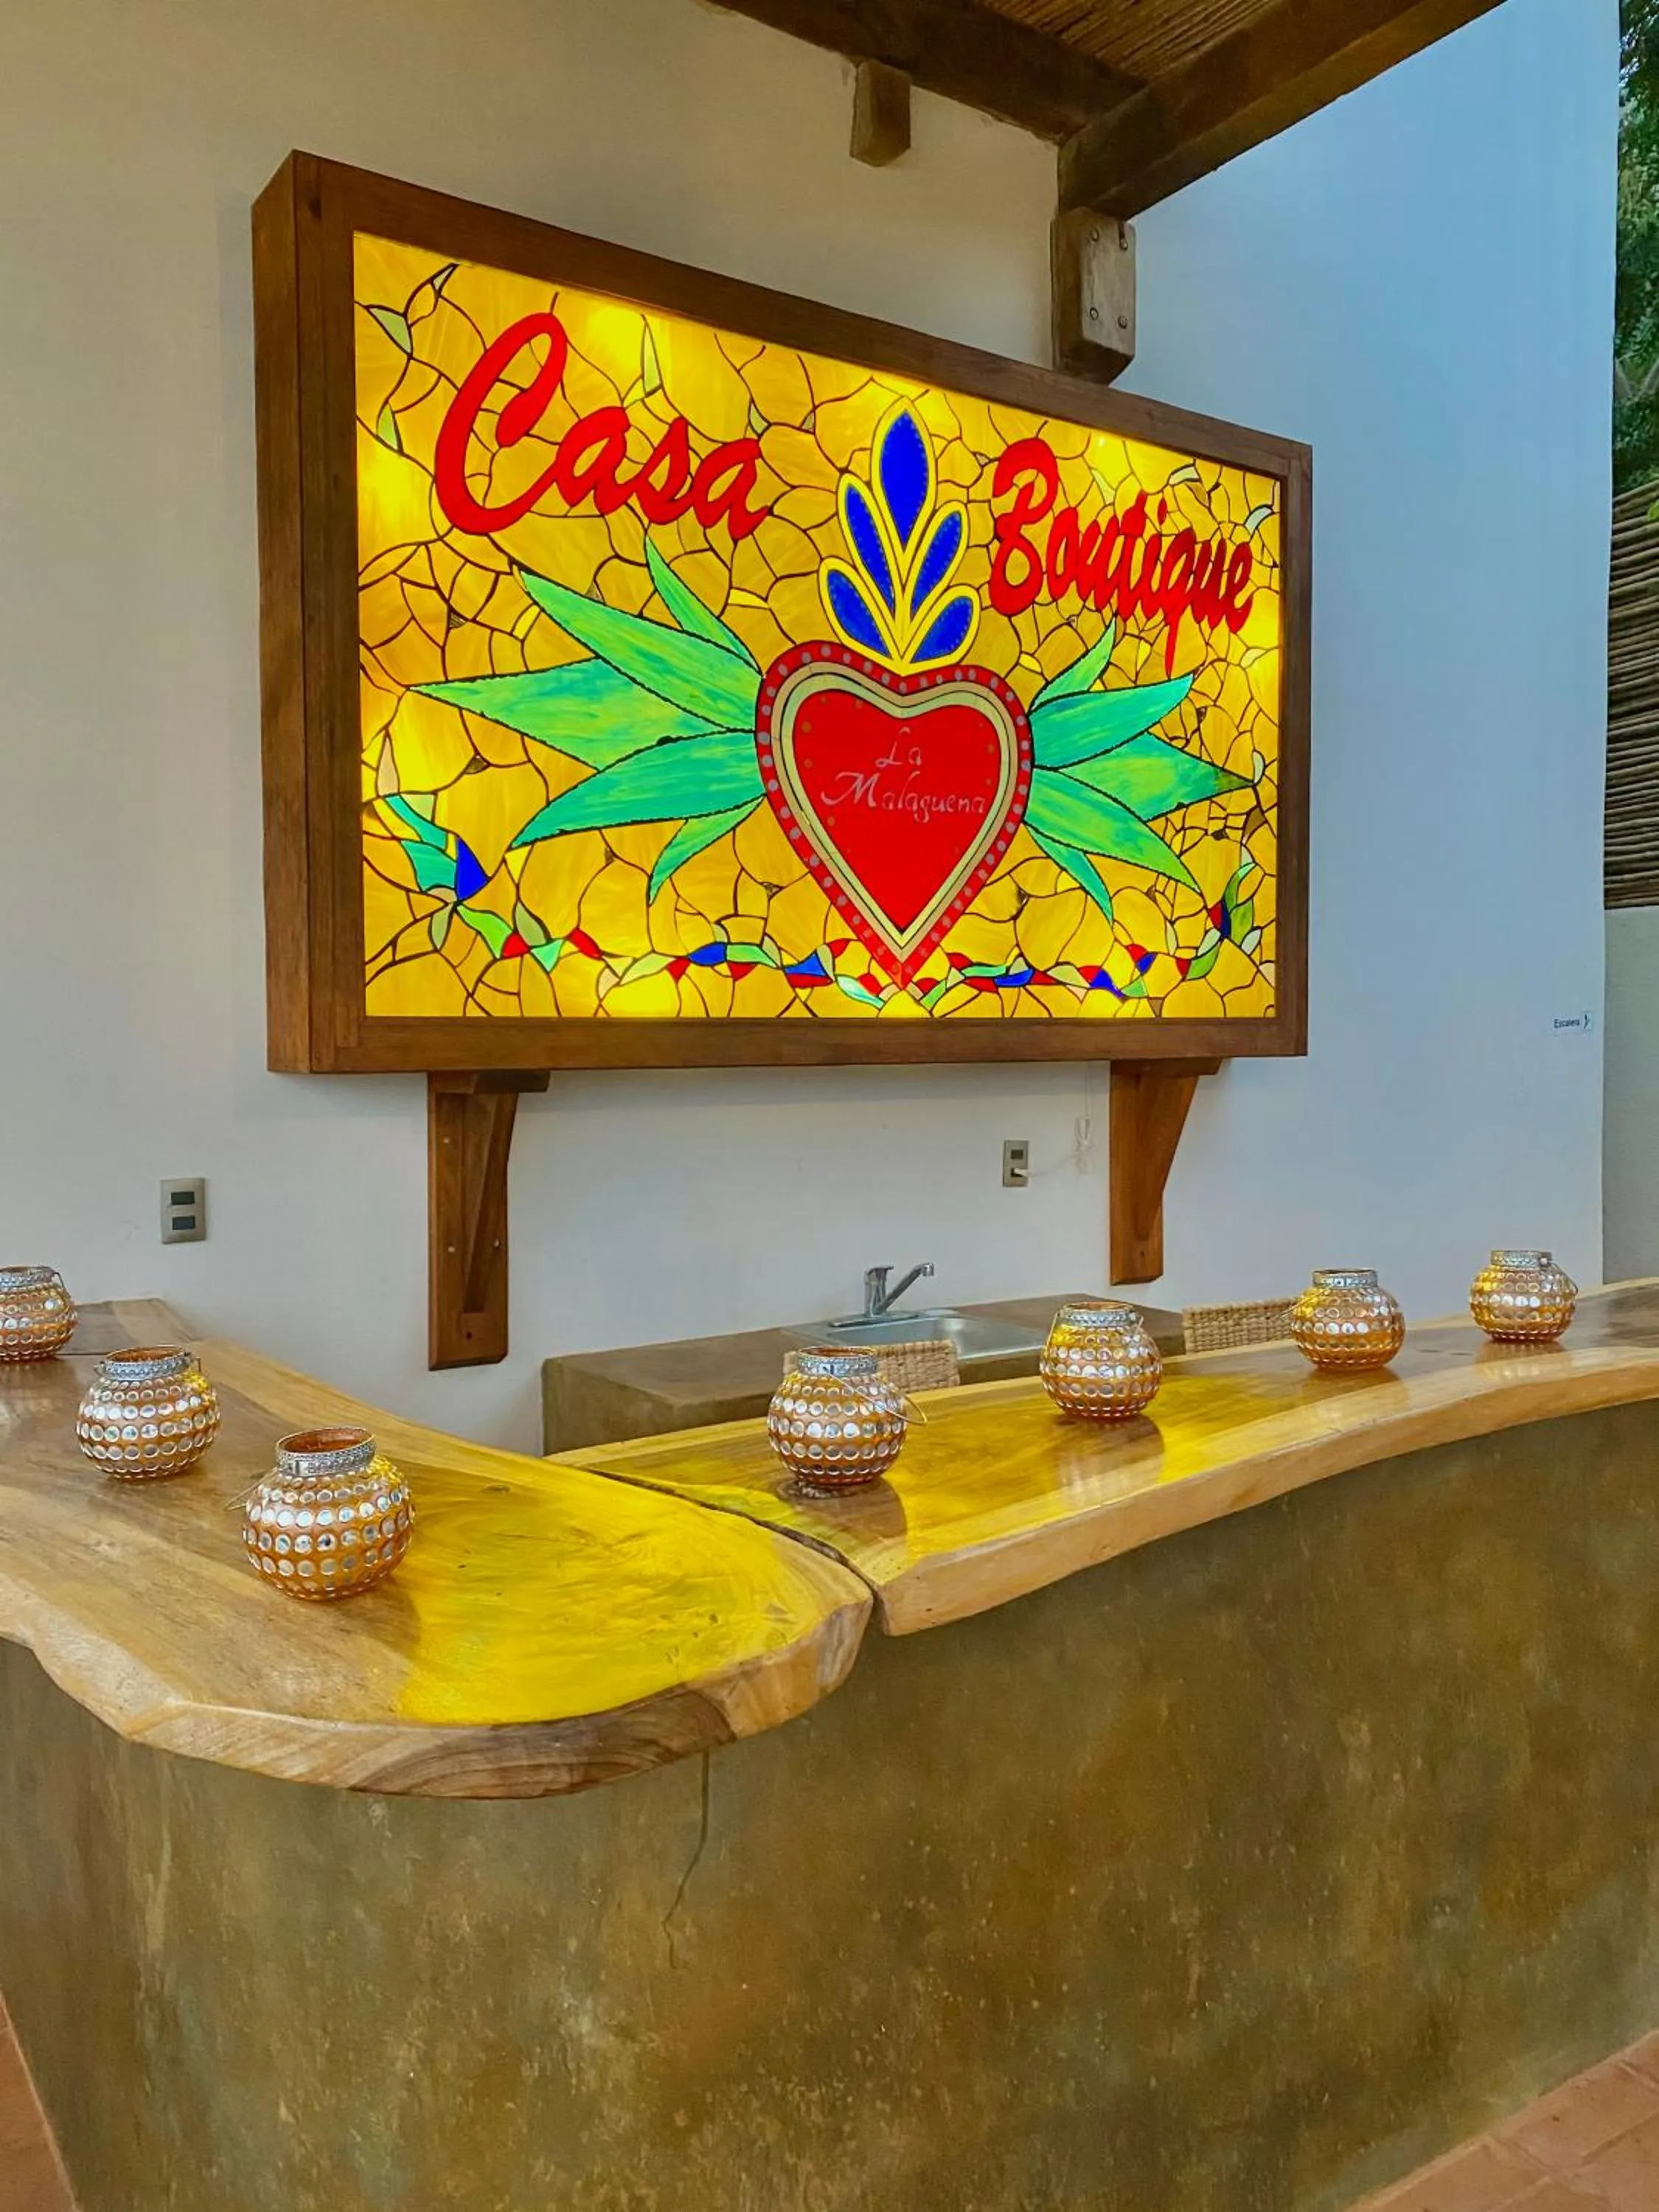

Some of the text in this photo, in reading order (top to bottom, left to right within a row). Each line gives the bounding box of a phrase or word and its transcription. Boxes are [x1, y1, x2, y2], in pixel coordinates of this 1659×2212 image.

[434, 312, 1254, 679] Casa Boutique
[874, 740, 922, 768] La
